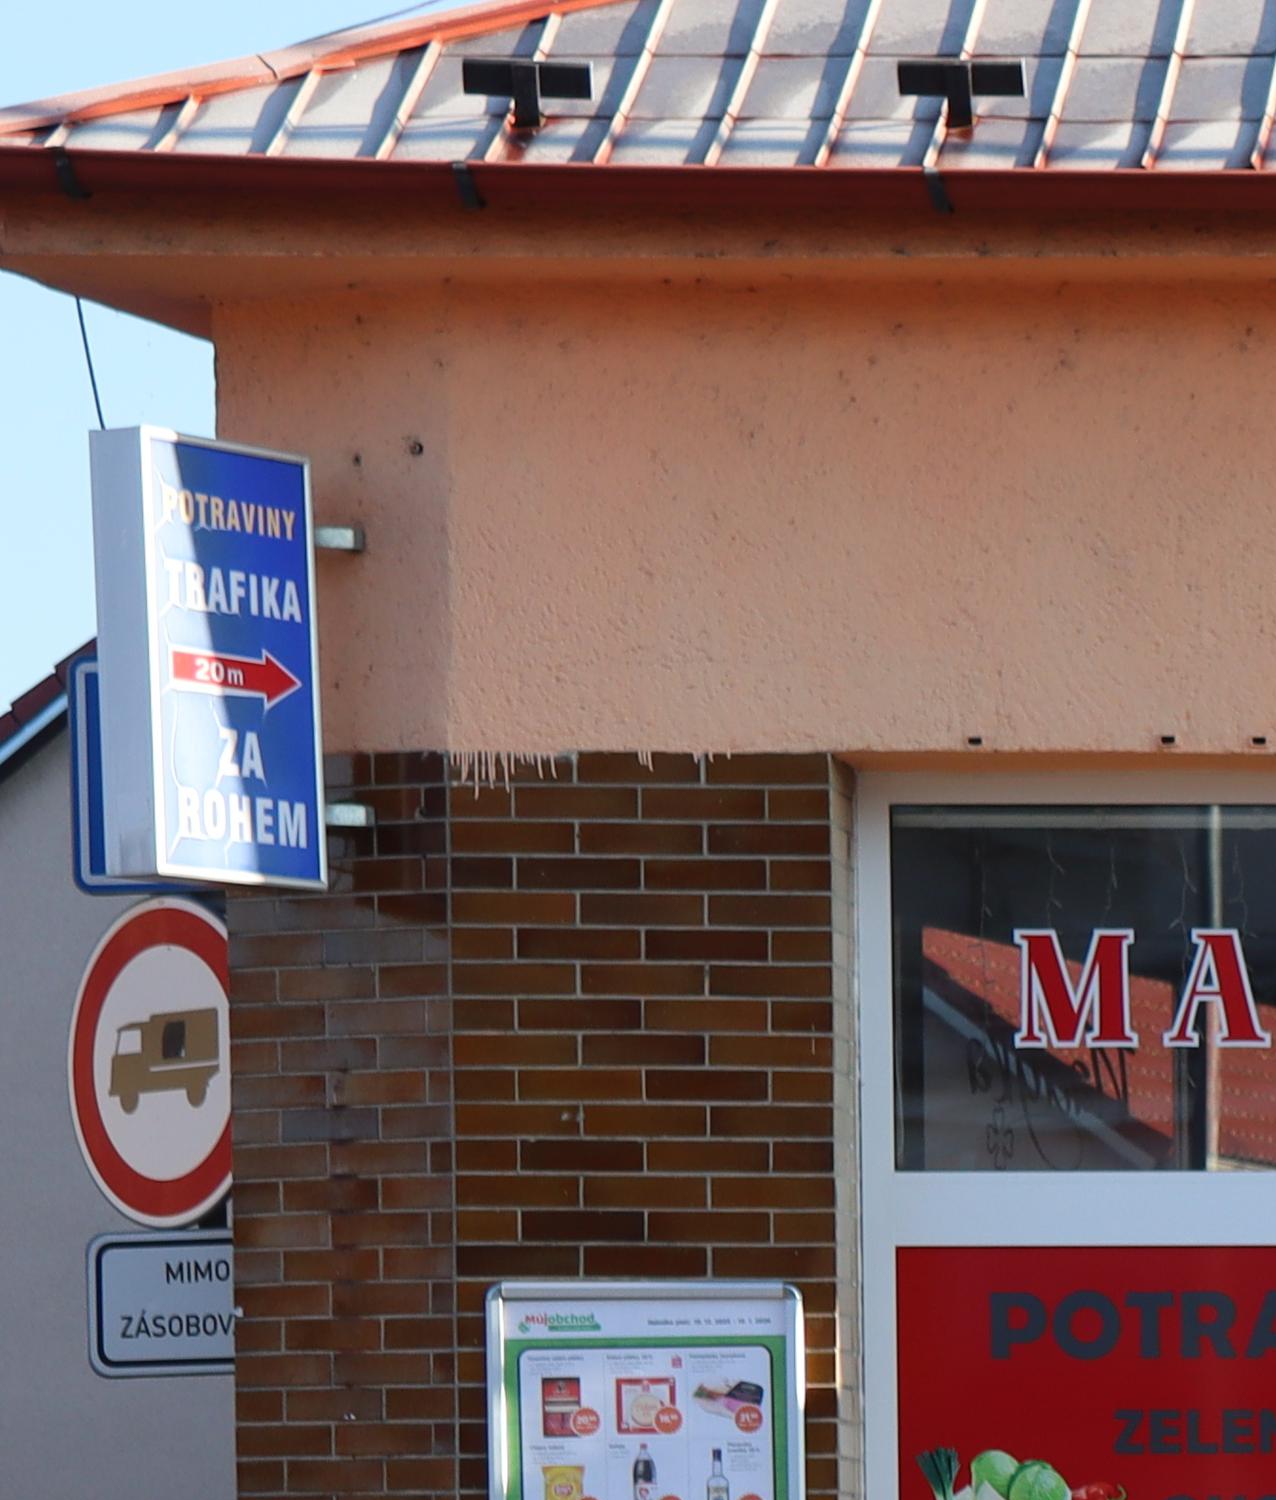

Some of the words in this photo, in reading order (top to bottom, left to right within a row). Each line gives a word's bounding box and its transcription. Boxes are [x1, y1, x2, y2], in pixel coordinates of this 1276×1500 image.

[161, 487, 296, 541] POTRAVINY
[164, 559, 302, 623] TRAFIKA
[220, 729, 265, 780] ZA
[180, 795, 307, 848] ROHEM
[165, 1259, 230, 1284] MIMO
[120, 1308, 234, 1338] ZÁSOBOV
